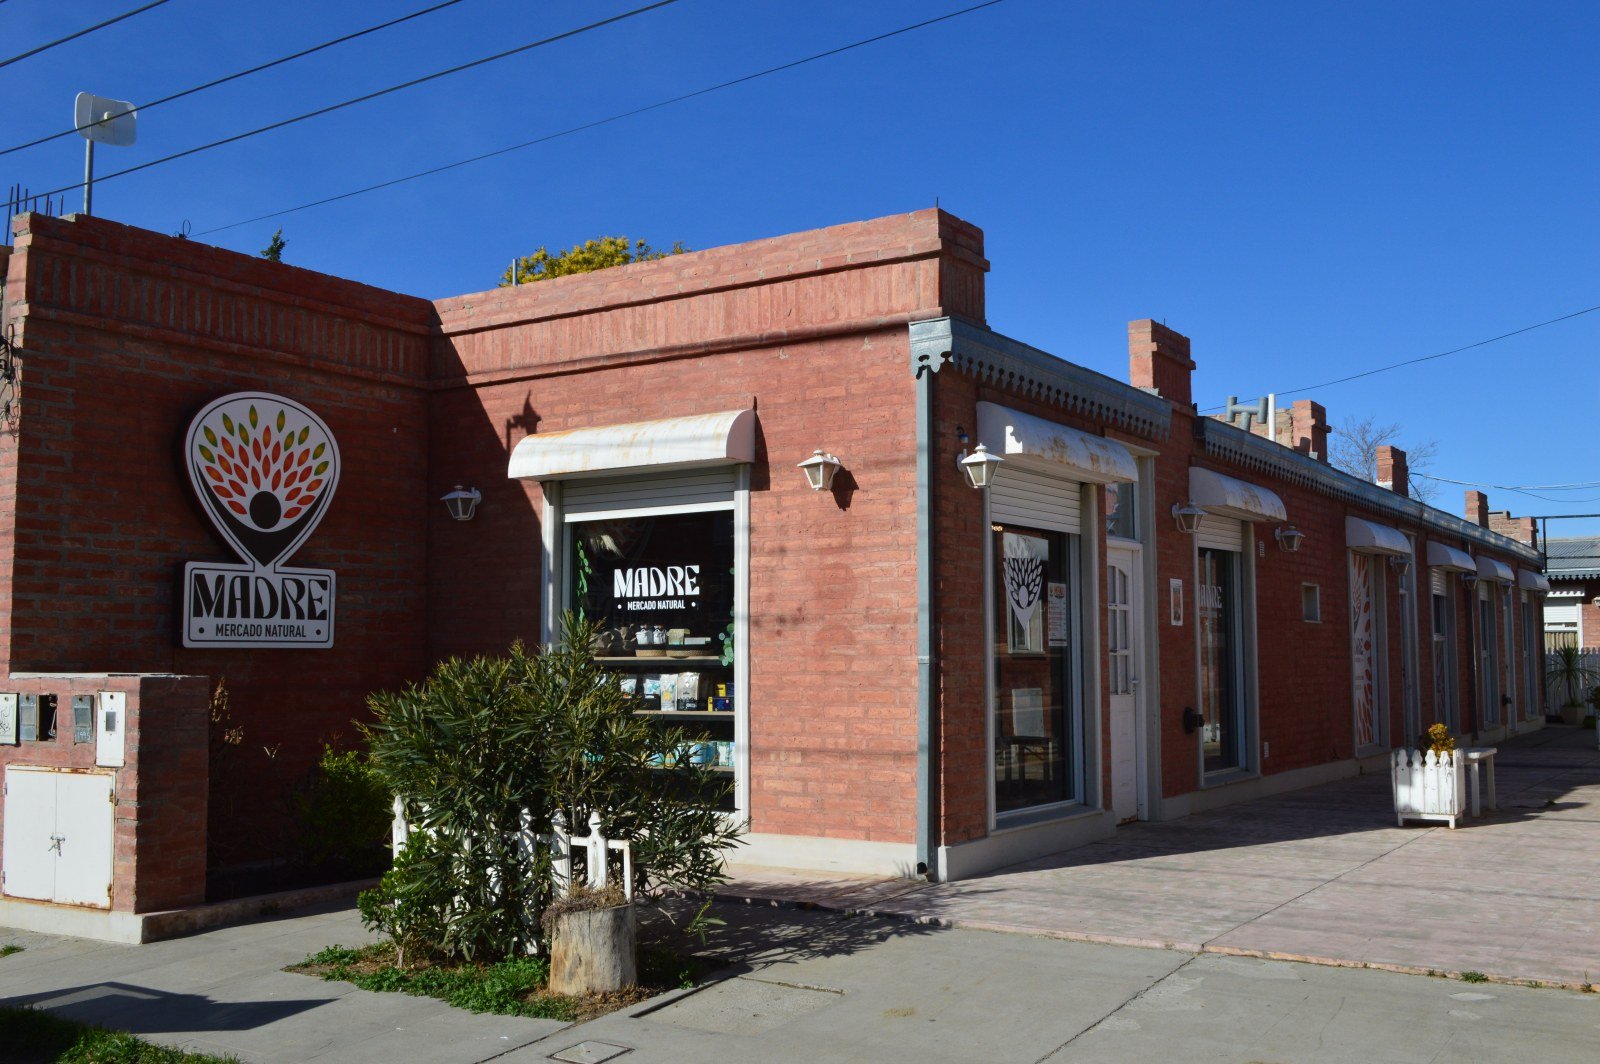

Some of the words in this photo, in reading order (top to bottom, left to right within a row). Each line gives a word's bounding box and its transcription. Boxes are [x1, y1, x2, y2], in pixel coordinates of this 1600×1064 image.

[613, 565, 700, 598] MADRE
[192, 573, 328, 621] MADRE
[627, 601, 657, 611] MERCADO
[657, 599, 686, 610] NATURAL
[1199, 584, 1223, 609] ADRE
[215, 623, 262, 637] MERCADO
[264, 624, 307, 638] NATURAL
